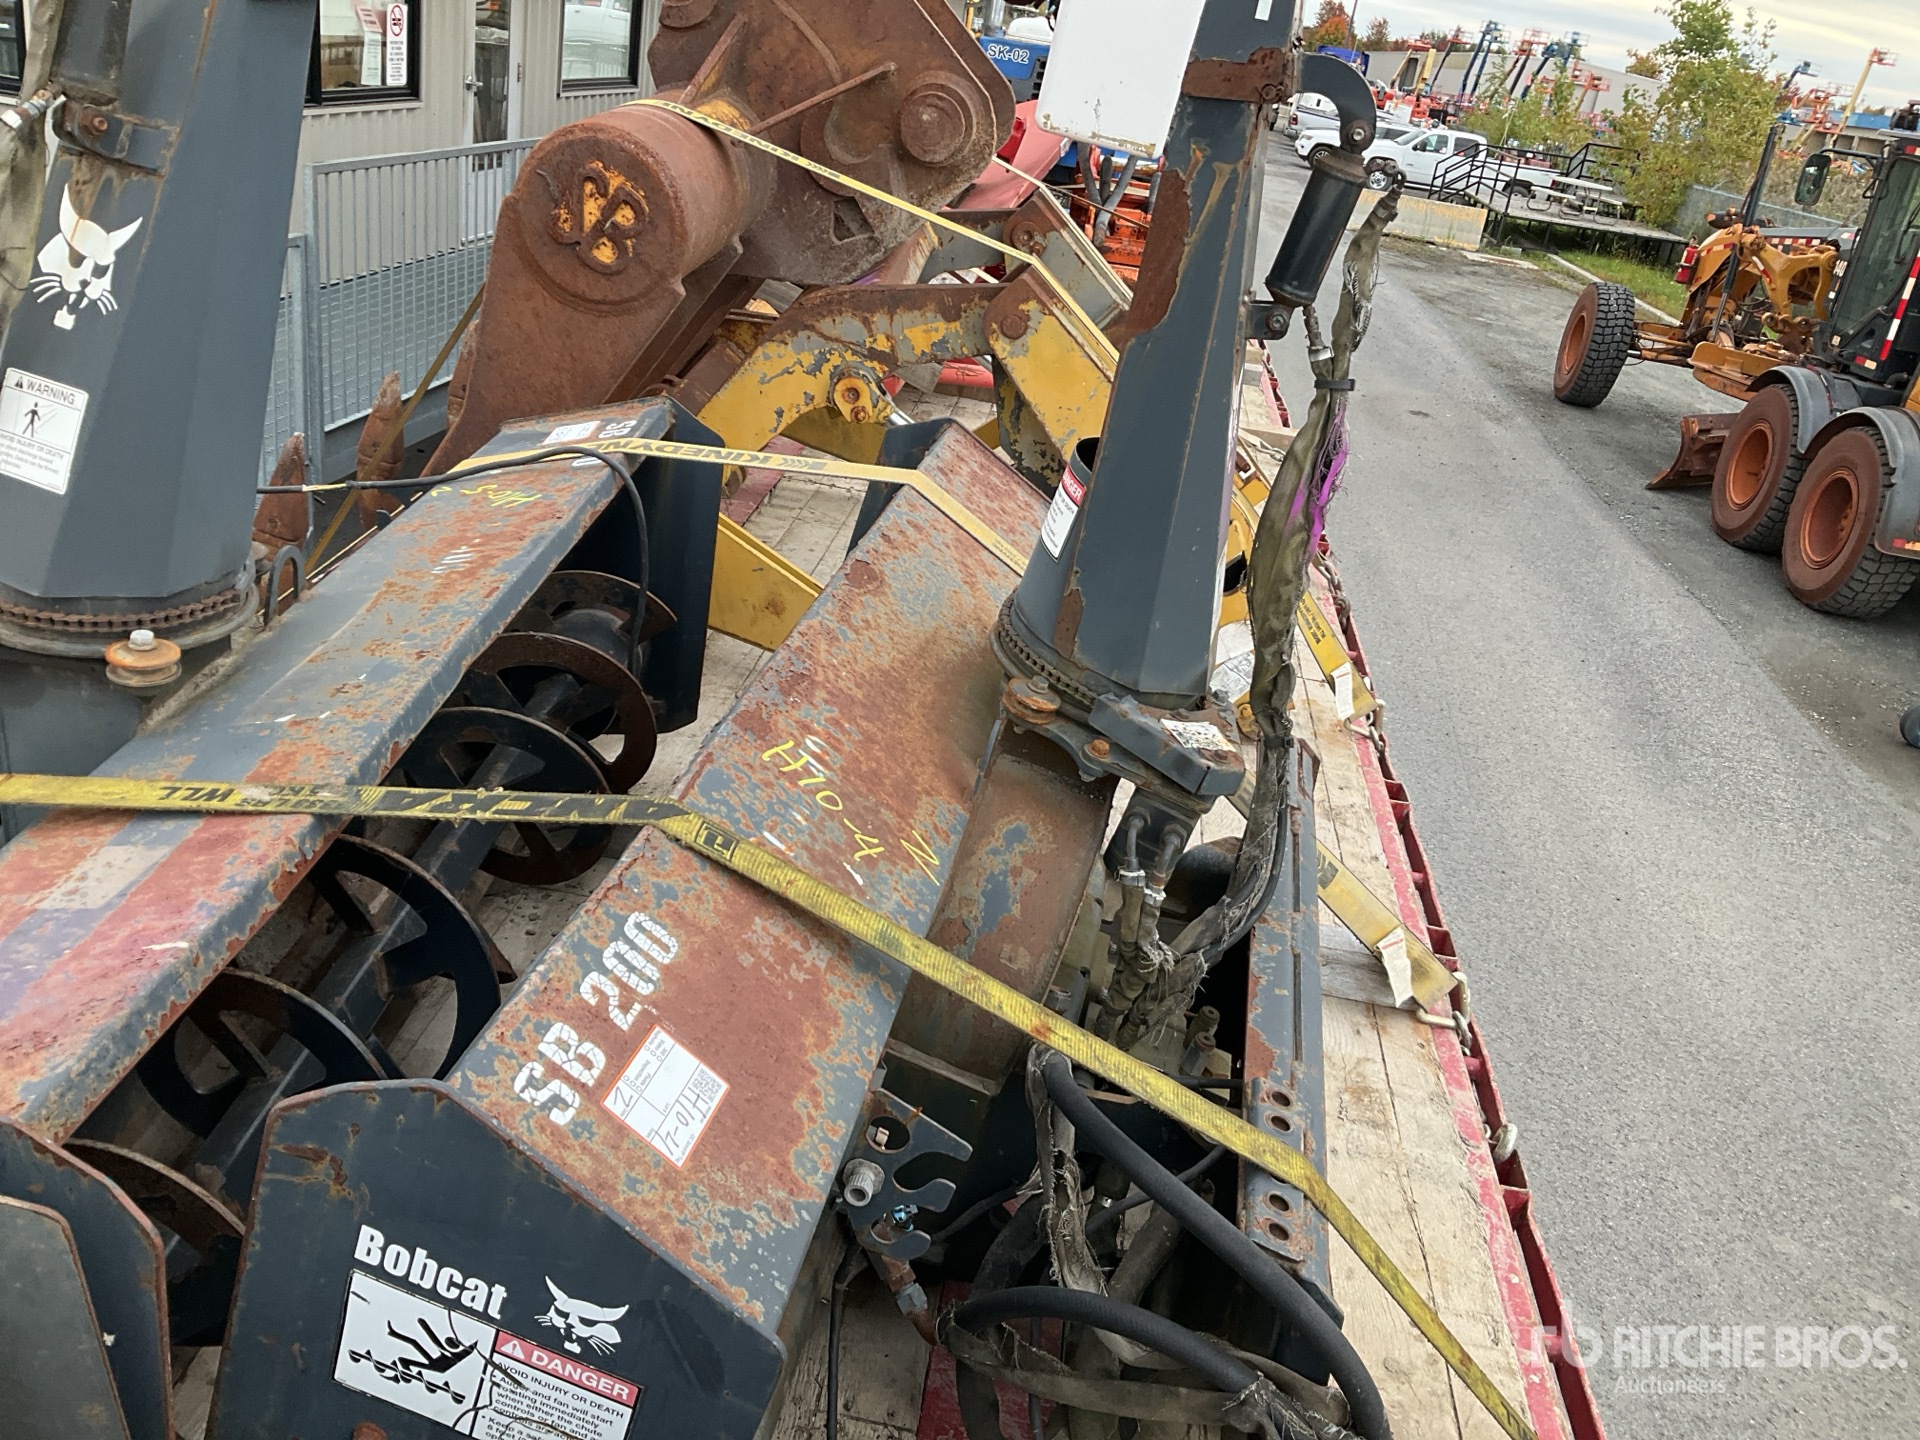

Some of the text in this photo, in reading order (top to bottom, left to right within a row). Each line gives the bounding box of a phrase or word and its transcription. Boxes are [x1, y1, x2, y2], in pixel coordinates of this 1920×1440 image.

[987, 44, 1030, 65] SK-02
[26, 379, 76, 405] WARNING
[598, 420, 637, 439] SB
[1062, 471, 1083, 501] ANGER
[158, 785, 236, 803] WLL
[513, 911, 679, 1126] SB 200
[353, 1224, 508, 1320] Bobcat
[498, 1362, 625, 1419] AVOID INJURY OR DEATH
[530, 1350, 630, 1401] DANGER
[494, 1398, 536, 1418] controls
[550, 1419, 568, 1434] fan
[569, 1428, 589, 1440] and
[496, 1391, 603, 1438] when either the chute
[531, 1389, 551, 1402] and
[553, 1396, 570, 1410] fan
[571, 1404, 589, 1417] will
[590, 1413, 615, 1427] start
[539, 1399, 600, 1430] immediately
